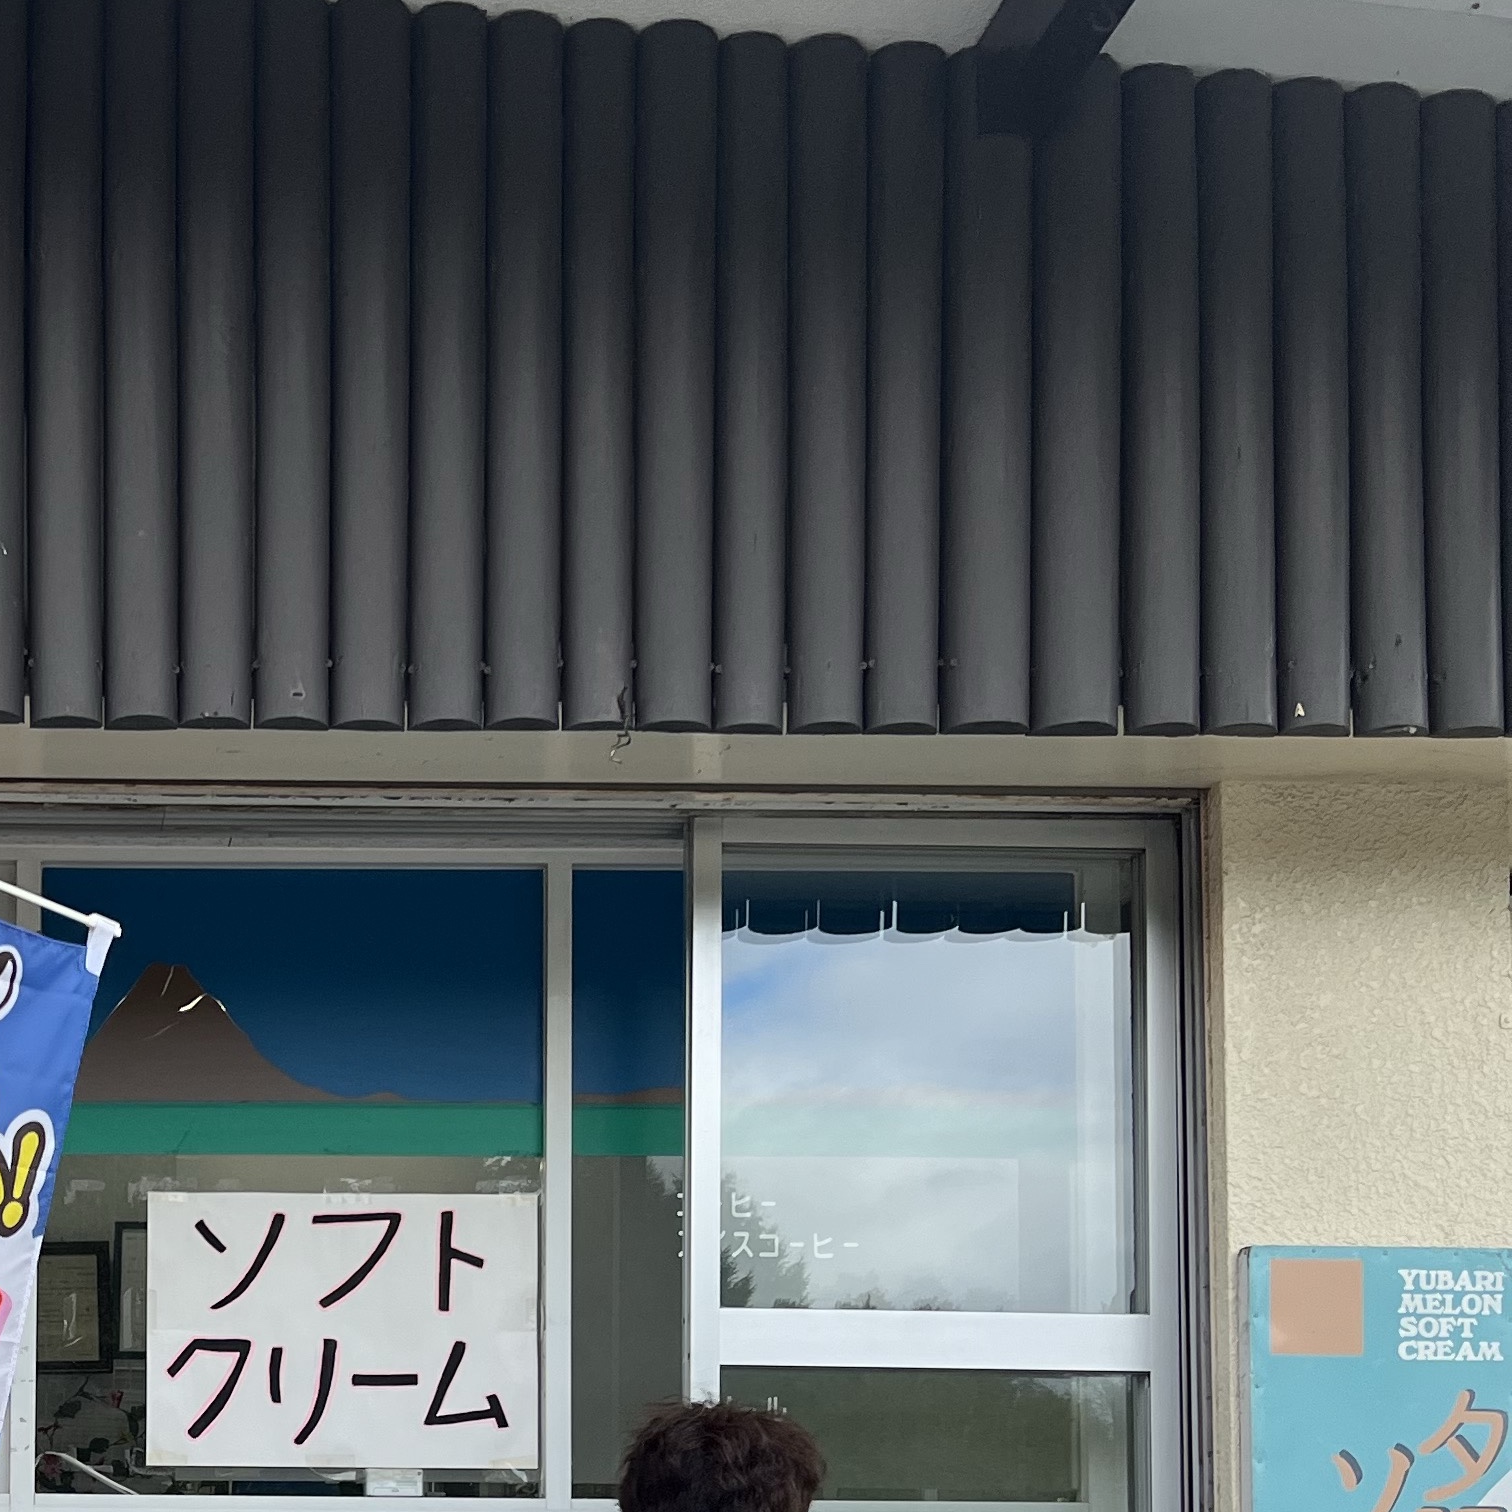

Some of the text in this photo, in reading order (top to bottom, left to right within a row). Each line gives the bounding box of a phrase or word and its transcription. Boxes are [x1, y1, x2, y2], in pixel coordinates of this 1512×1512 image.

[719, 1230, 860, 1259] スコーヒー
[194, 1210, 485, 1313] ソフト
[1398, 1269, 1505, 1292] YUBARI
[1397, 1293, 1504, 1315] MELON
[1398, 1317, 1479, 1339] SOFT
[1397, 1341, 1505, 1362] CREAM
[166, 1337, 510, 1446] クリーム
